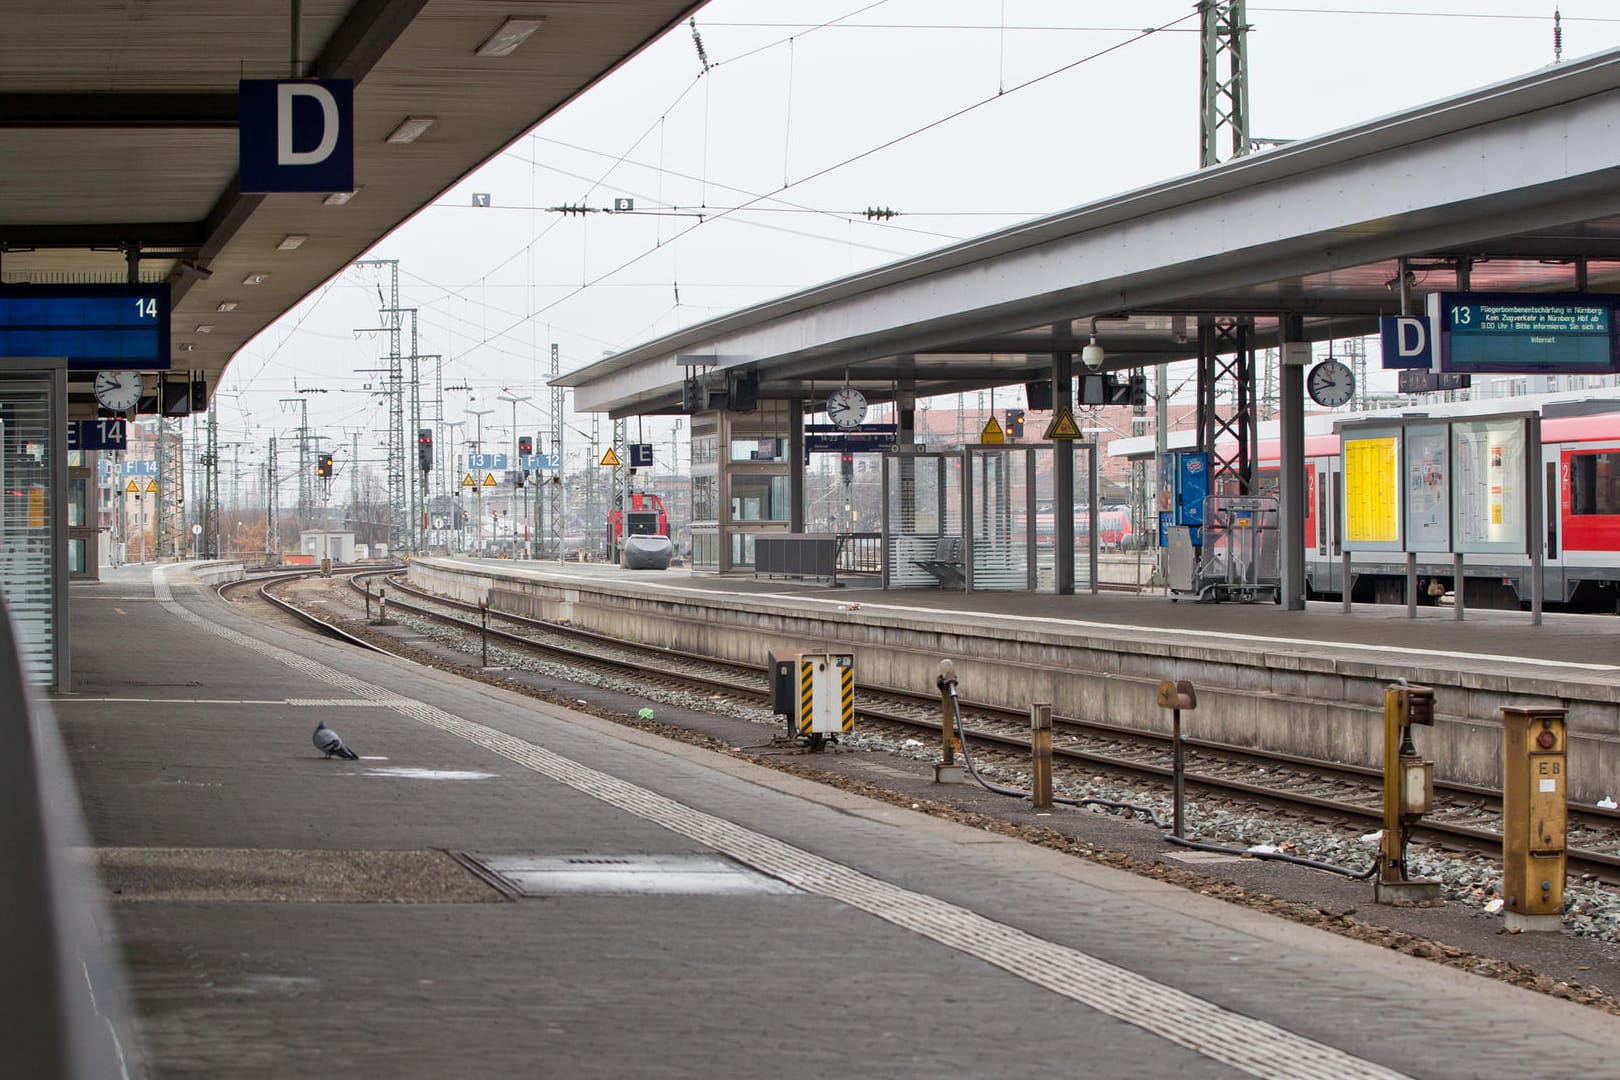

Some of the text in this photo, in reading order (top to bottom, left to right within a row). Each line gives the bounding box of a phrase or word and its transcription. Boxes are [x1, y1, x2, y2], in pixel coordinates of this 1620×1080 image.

[277, 83, 339, 166] D
[135, 298, 158, 318] 14
[1451, 306, 1471, 325] 13
[1502, 314, 1537, 322] Zugverkehr
[1515, 322, 1530, 330] Bitte
[1533, 322, 1567, 330] informieren
[1397, 318, 1425, 357] D
[96, 420, 122, 444] 14
[471, 456, 501, 466] 13 F
[528, 456, 560, 466] F 12
[640, 445, 652, 461] E
[126, 461, 158, 473] F 14
[1563, 464, 1568, 482] 2
